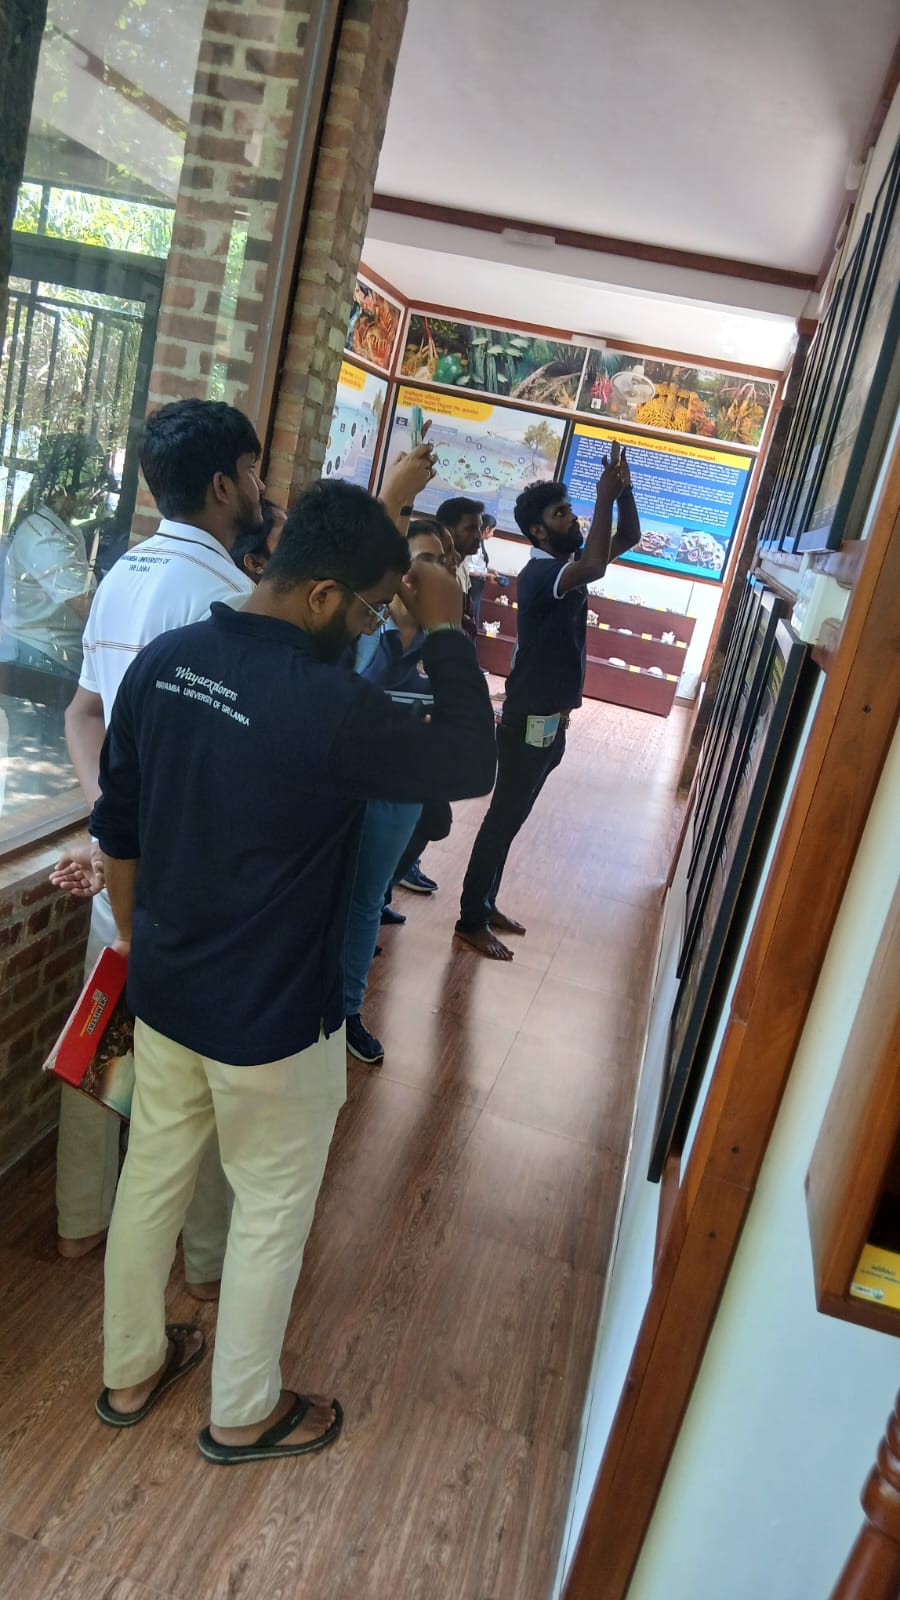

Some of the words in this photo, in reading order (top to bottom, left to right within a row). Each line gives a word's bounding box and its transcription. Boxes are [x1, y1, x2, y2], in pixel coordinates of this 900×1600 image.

[183, 687, 213, 705] UNIVERSITY
[213, 700, 221, 709] OF
[221, 703, 231, 714] SRI
[230, 709, 250, 726] LANKA
